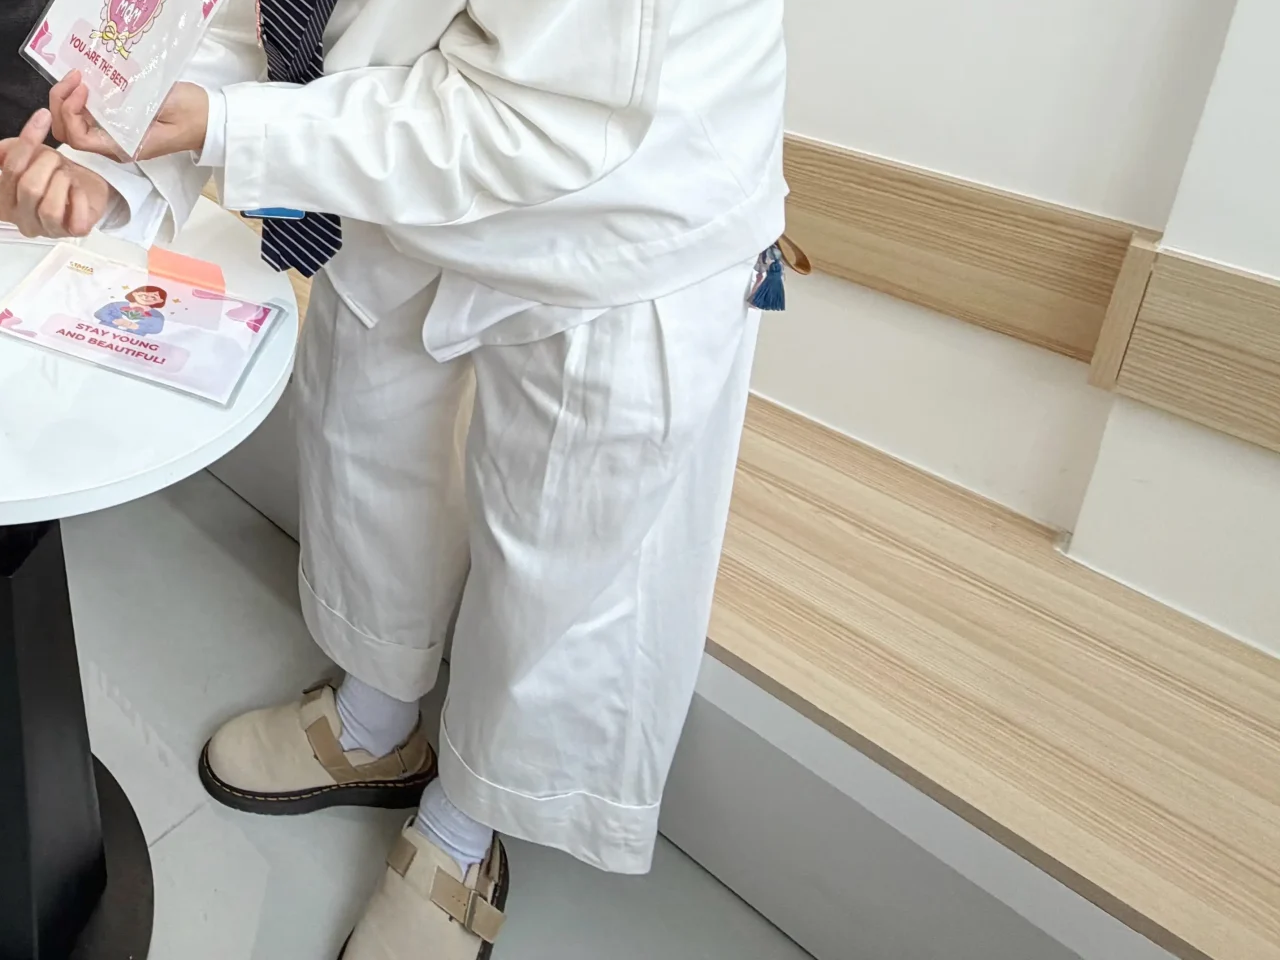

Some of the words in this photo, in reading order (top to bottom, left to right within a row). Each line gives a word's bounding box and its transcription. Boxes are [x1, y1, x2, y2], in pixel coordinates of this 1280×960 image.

[69, 33, 87, 53] YOU
[83, 47, 102, 66] ARE
[98, 58, 114, 76] THE
[56, 327, 86, 342] AND
[87, 336, 166, 365] BEAUTIFUL!
[75, 322, 110, 337] STAY
[112, 332, 160, 352] YOUNG
